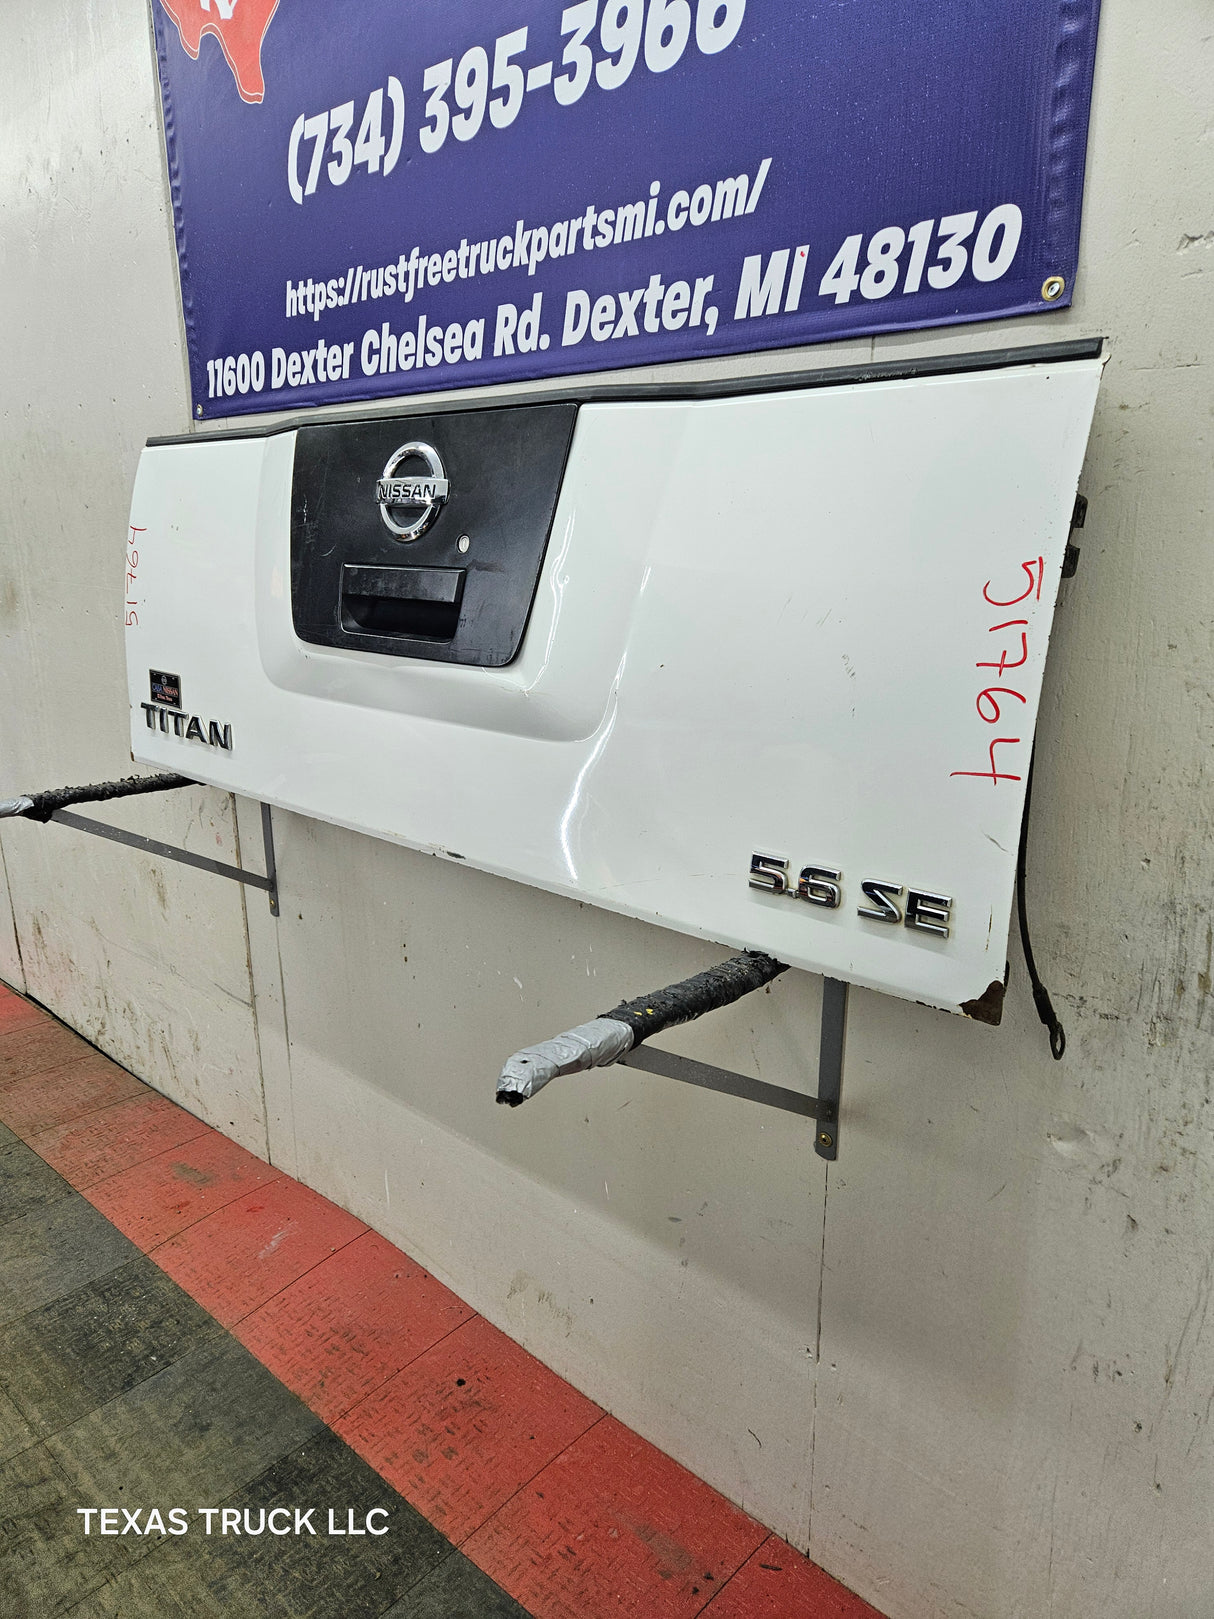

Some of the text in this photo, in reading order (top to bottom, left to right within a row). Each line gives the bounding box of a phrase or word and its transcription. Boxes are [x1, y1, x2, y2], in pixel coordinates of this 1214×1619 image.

[288, 76, 405, 205] (734)
[206, 203, 1023, 399] 11600 Dexter Chelsea Rd. Dexter, MI 48130
[285, 158, 773, 320] https://rustfreetruckpartsmi.com/
[378, 484, 436, 498] NISSAN
[141, 702, 232, 751] TITAN
[949, 556, 1043, 786] 51764
[748, 850, 952, 938] 5.6 SE
